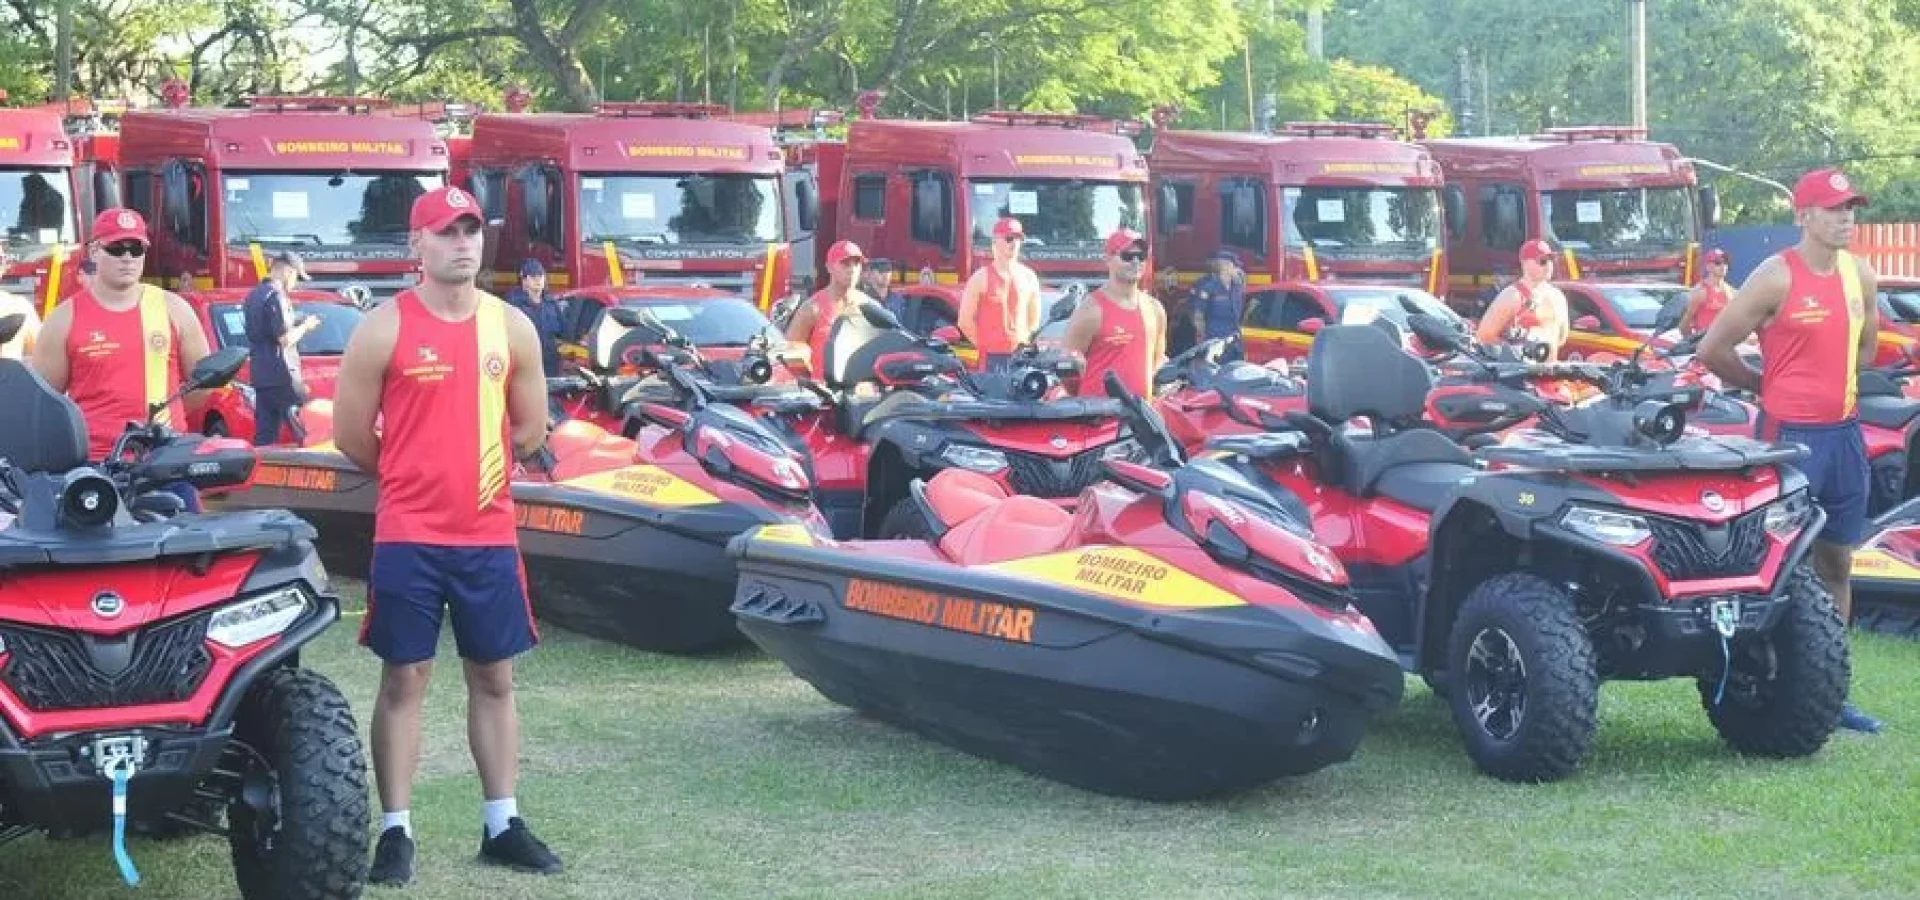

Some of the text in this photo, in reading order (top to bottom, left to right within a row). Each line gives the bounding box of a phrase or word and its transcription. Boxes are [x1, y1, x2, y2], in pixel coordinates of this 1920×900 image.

[1077, 553, 1168, 580] BOMBEIRO
[1075, 568, 1147, 594] MILITAR
[845, 579, 1035, 642] BOMBEIRO MILITAR
